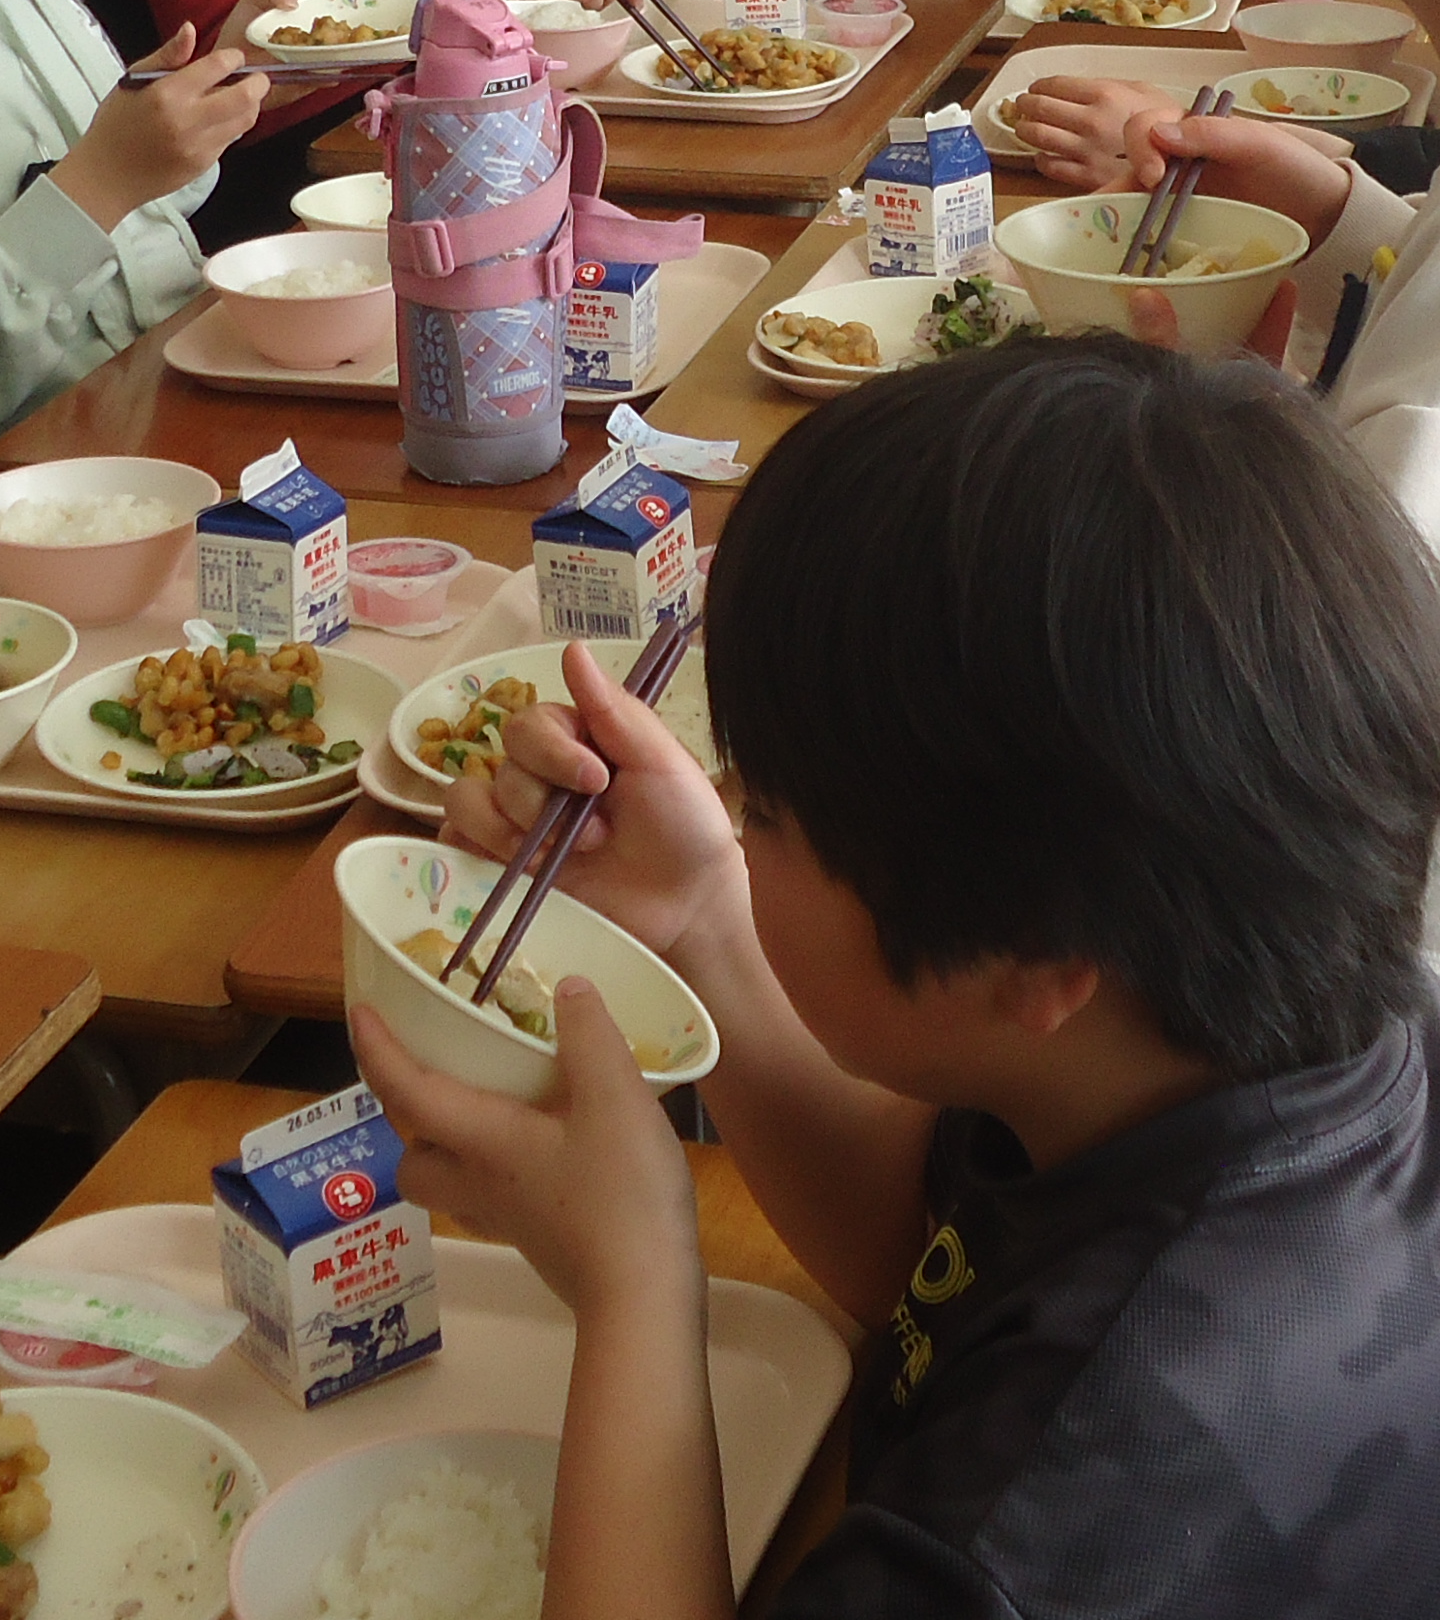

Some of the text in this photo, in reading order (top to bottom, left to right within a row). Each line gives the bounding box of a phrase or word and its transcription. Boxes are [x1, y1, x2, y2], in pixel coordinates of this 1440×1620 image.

[874, 193, 922, 213] 黒東牛乳
[492, 373, 541, 394] THERMOS
[303, 536, 342, 570] 黒東牛乳
[646, 532, 687, 577] 黒東牛乳
[286, 1098, 344, 1132] 26.03.11
[271, 1126, 372, 1179] 自然のおいしさ
[289, 1143, 376, 1189] 黒東牛乳
[312, 1225, 411, 1286] 黒東牛乳
